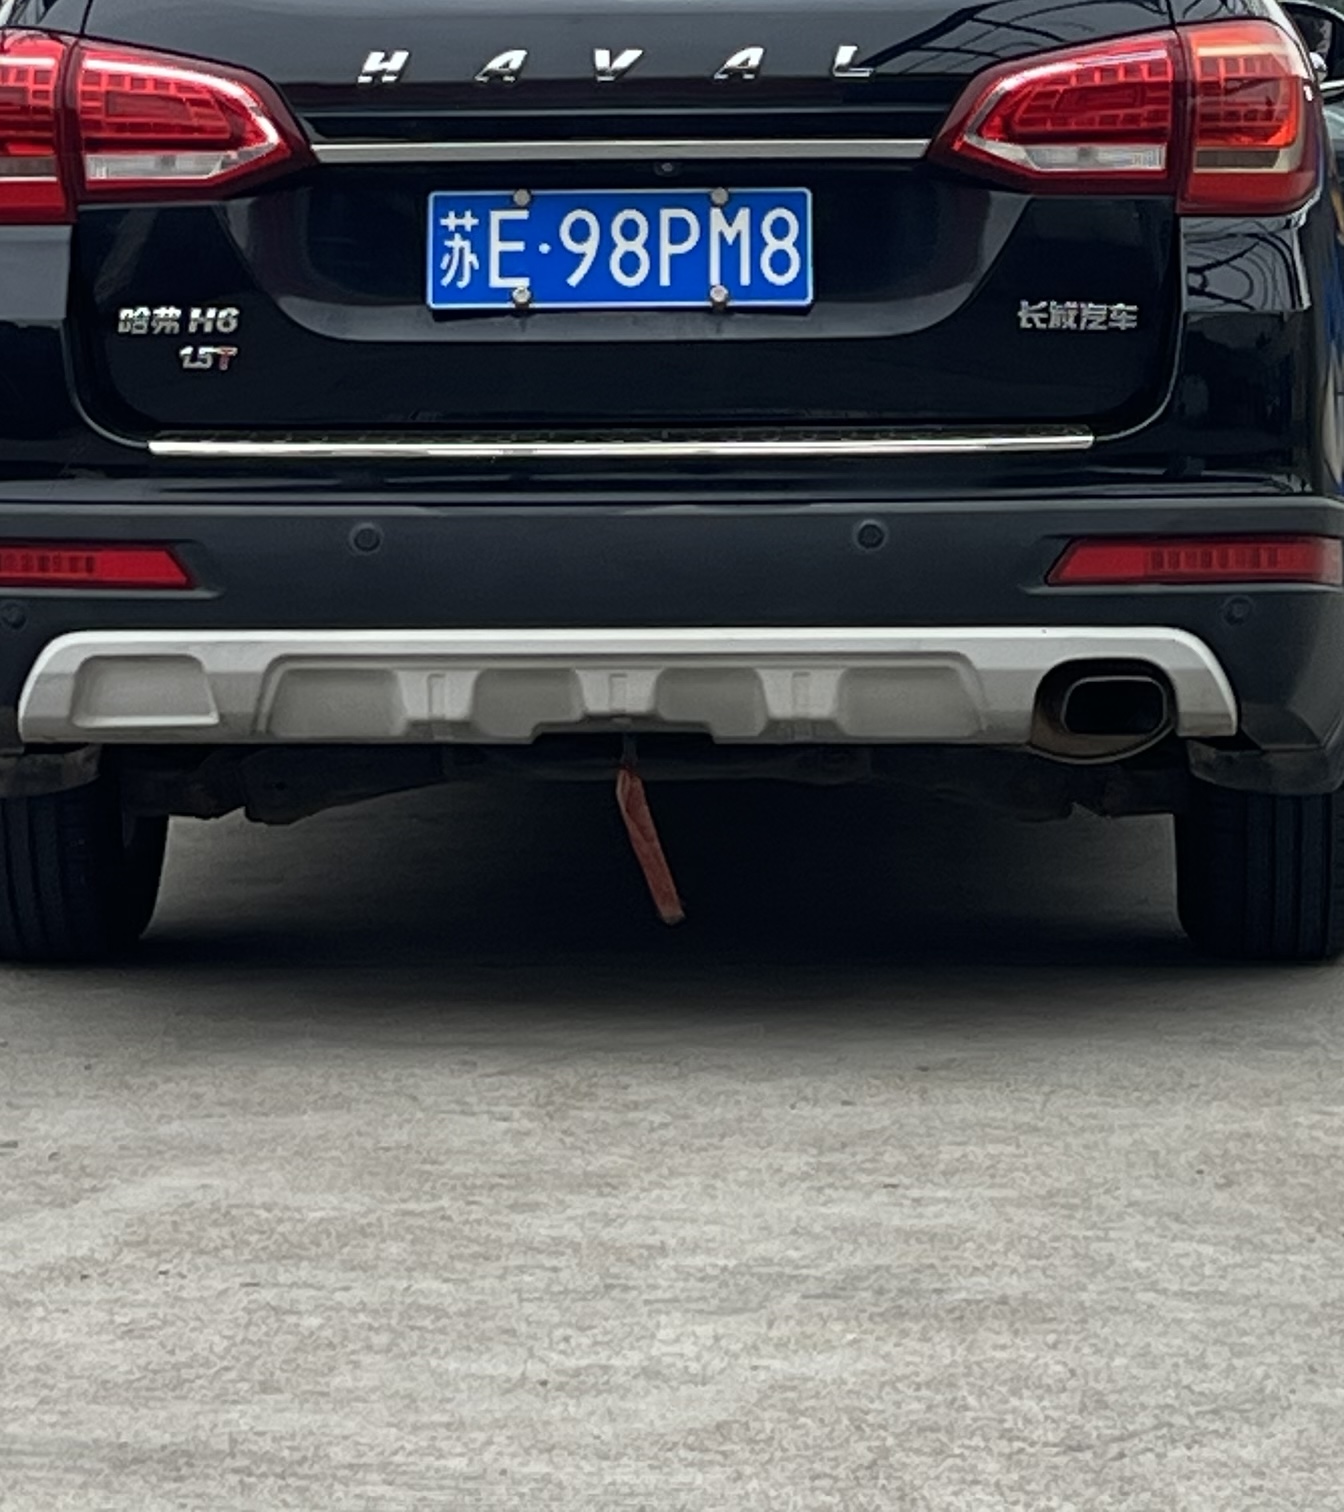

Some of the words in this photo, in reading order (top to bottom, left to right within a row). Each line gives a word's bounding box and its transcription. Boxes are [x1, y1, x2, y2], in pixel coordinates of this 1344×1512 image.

[357, 45, 875, 84] HAVAL
[118, 305, 182, 336] 哈弗
[188, 306, 240, 334] H6
[1017, 299, 1138, 331] 长城汽车
